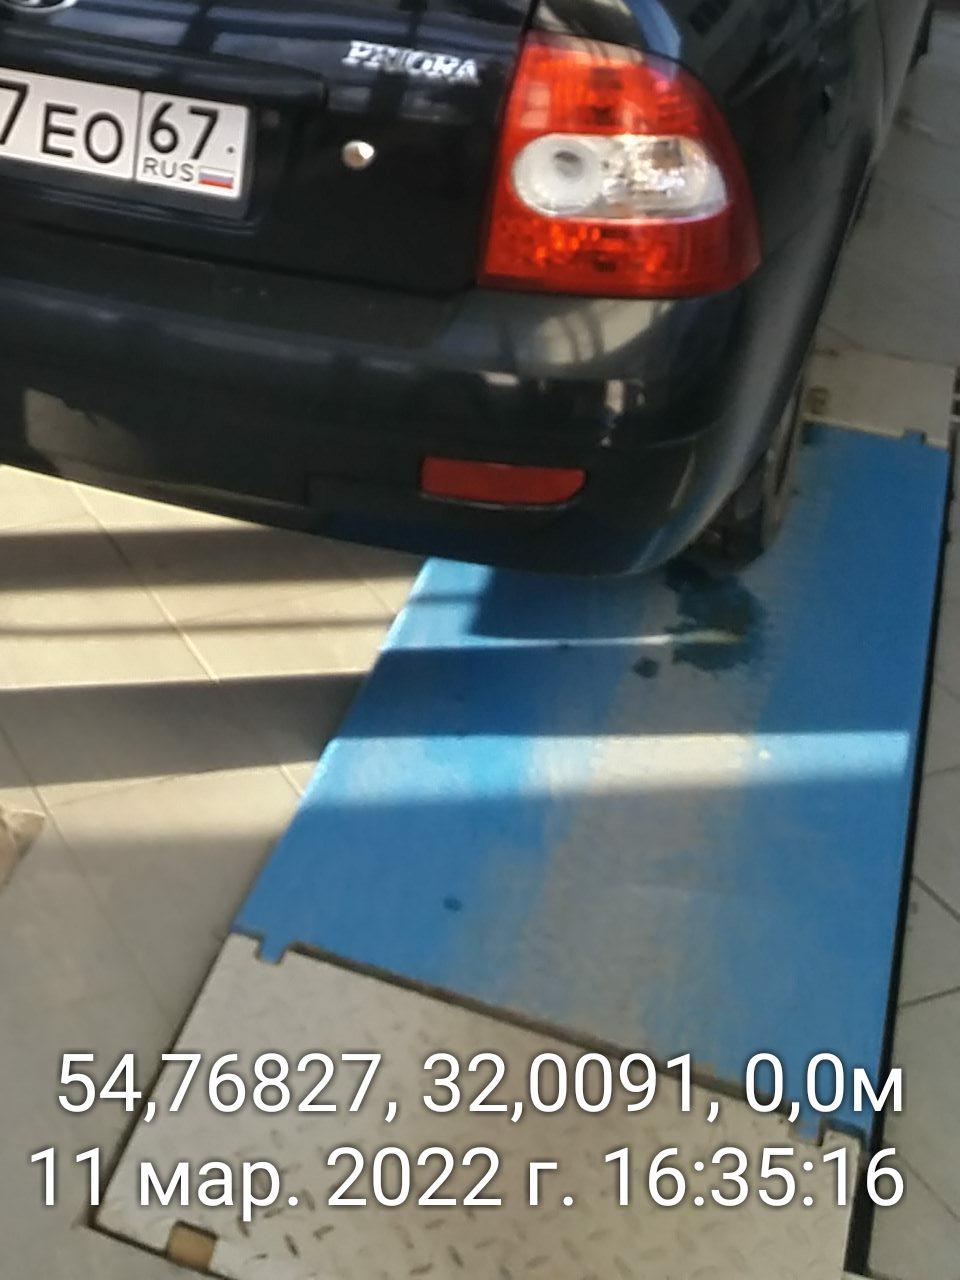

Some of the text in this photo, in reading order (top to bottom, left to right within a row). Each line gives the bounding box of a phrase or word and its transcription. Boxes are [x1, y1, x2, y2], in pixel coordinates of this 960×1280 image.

[342, 39, 480, 87] PRIORA
[148, 101, 221, 161] 67
[142, 156, 194, 183] RUS
